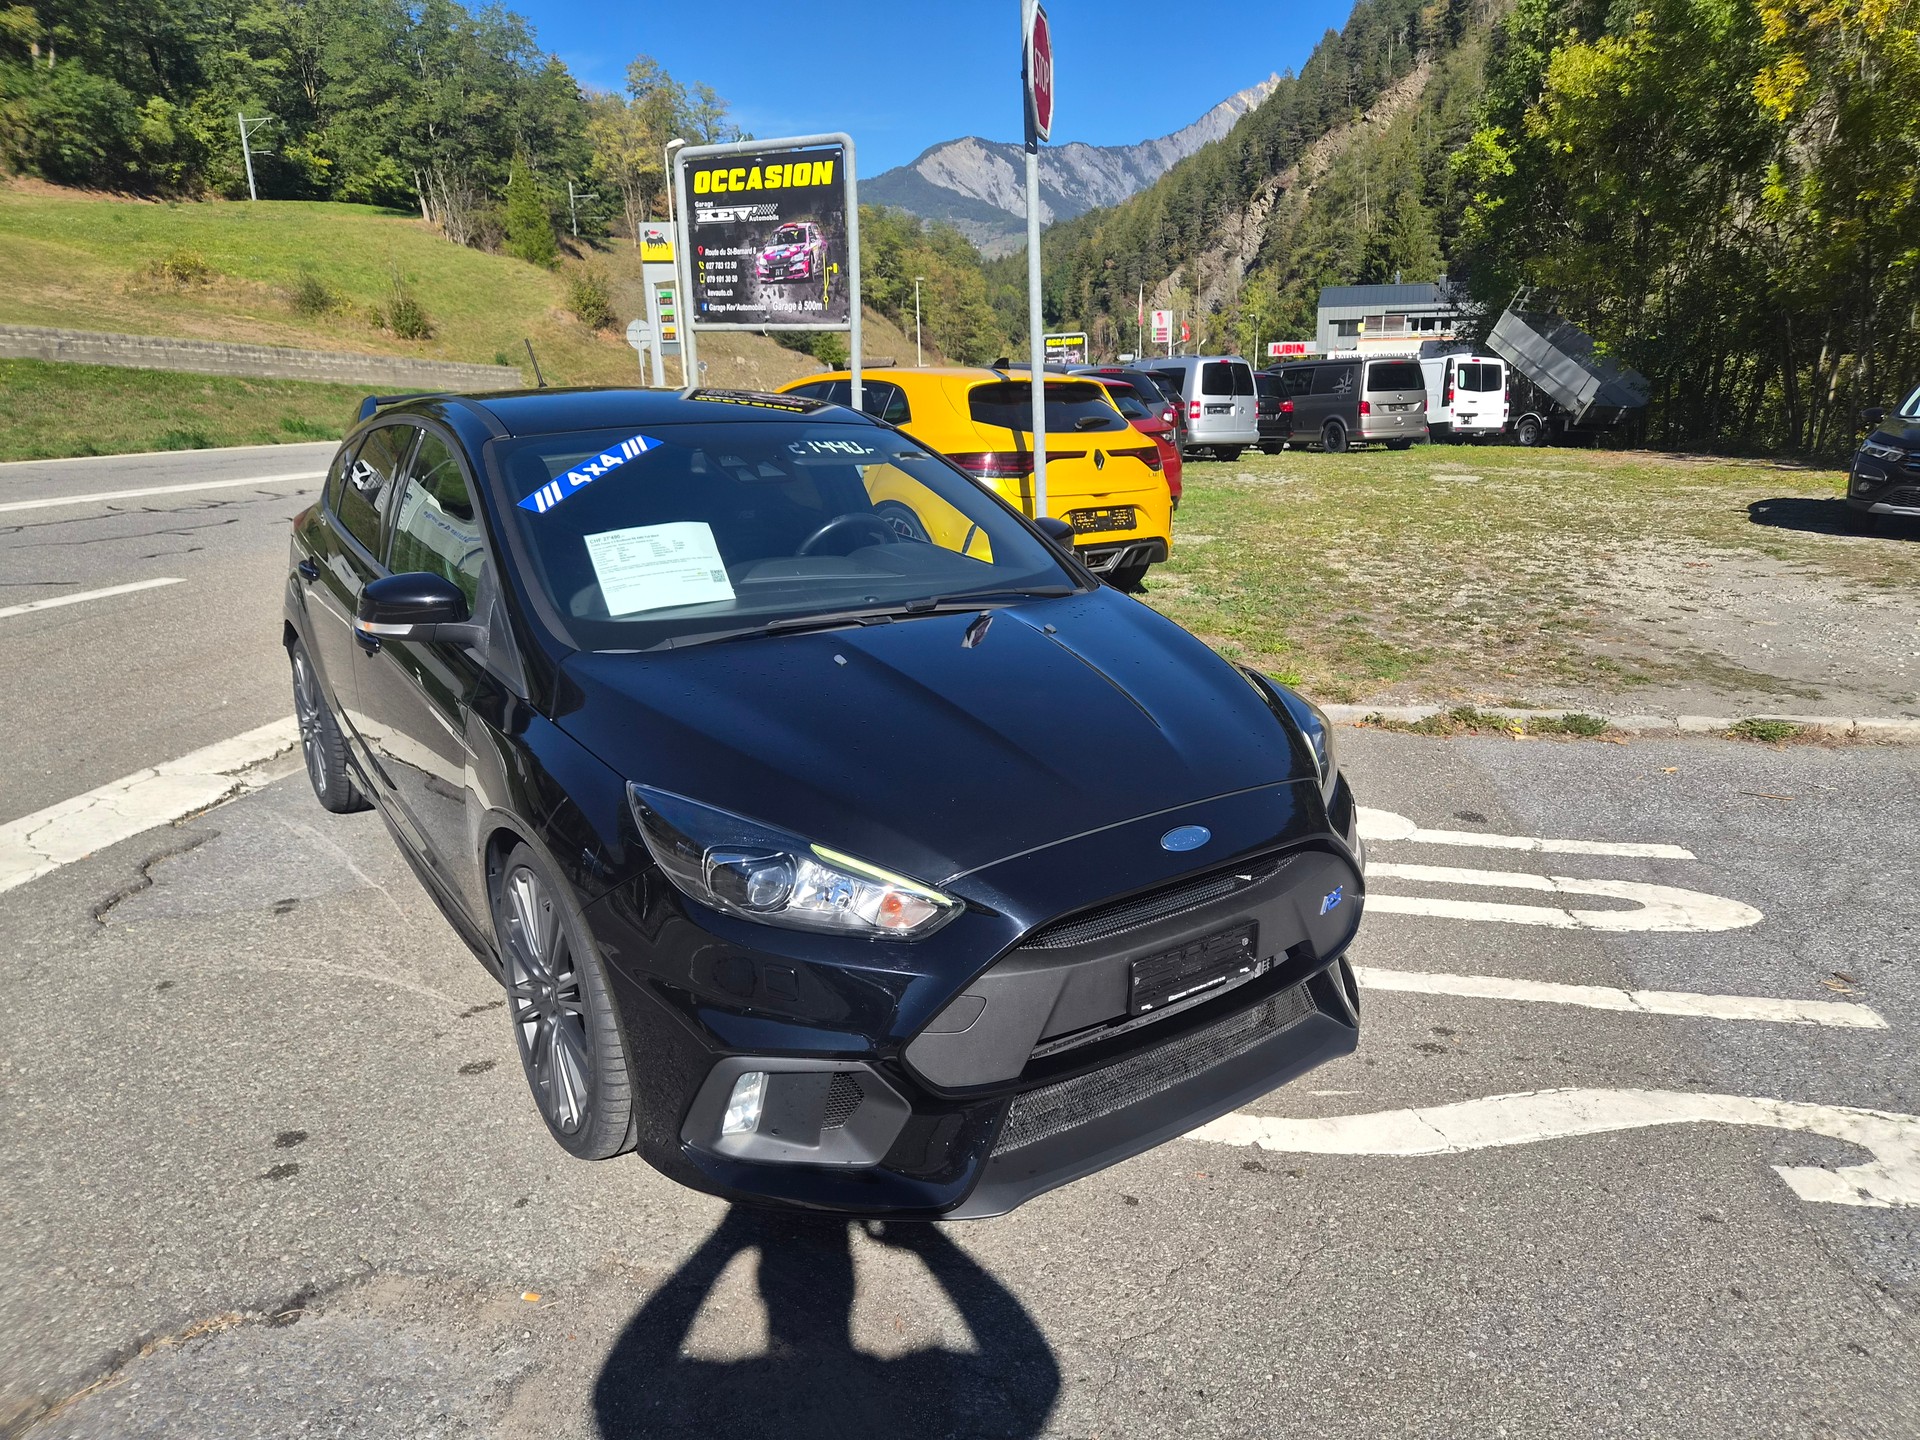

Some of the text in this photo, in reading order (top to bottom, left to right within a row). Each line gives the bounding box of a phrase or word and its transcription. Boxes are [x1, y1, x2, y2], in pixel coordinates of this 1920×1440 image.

[1035, 47, 1049, 96] STOP
[694, 161, 834, 194] OCCASION
[705, 248, 719, 256] Route
[727, 247, 752, 255] St-Bernard
[706, 261, 715, 269] 027
[725, 261, 731, 269] 12
[731, 261, 737, 269] 50
[707, 275, 716, 283] 079
[732, 275, 738, 283] 50
[707, 289, 733, 297] kevauto.ch
[709, 304, 726, 313] Garage
[773, 300, 822, 313] Garage à 500m
[1046, 337, 1083, 346] OCCASION
[1273, 344, 1305, 355] JUBIN
